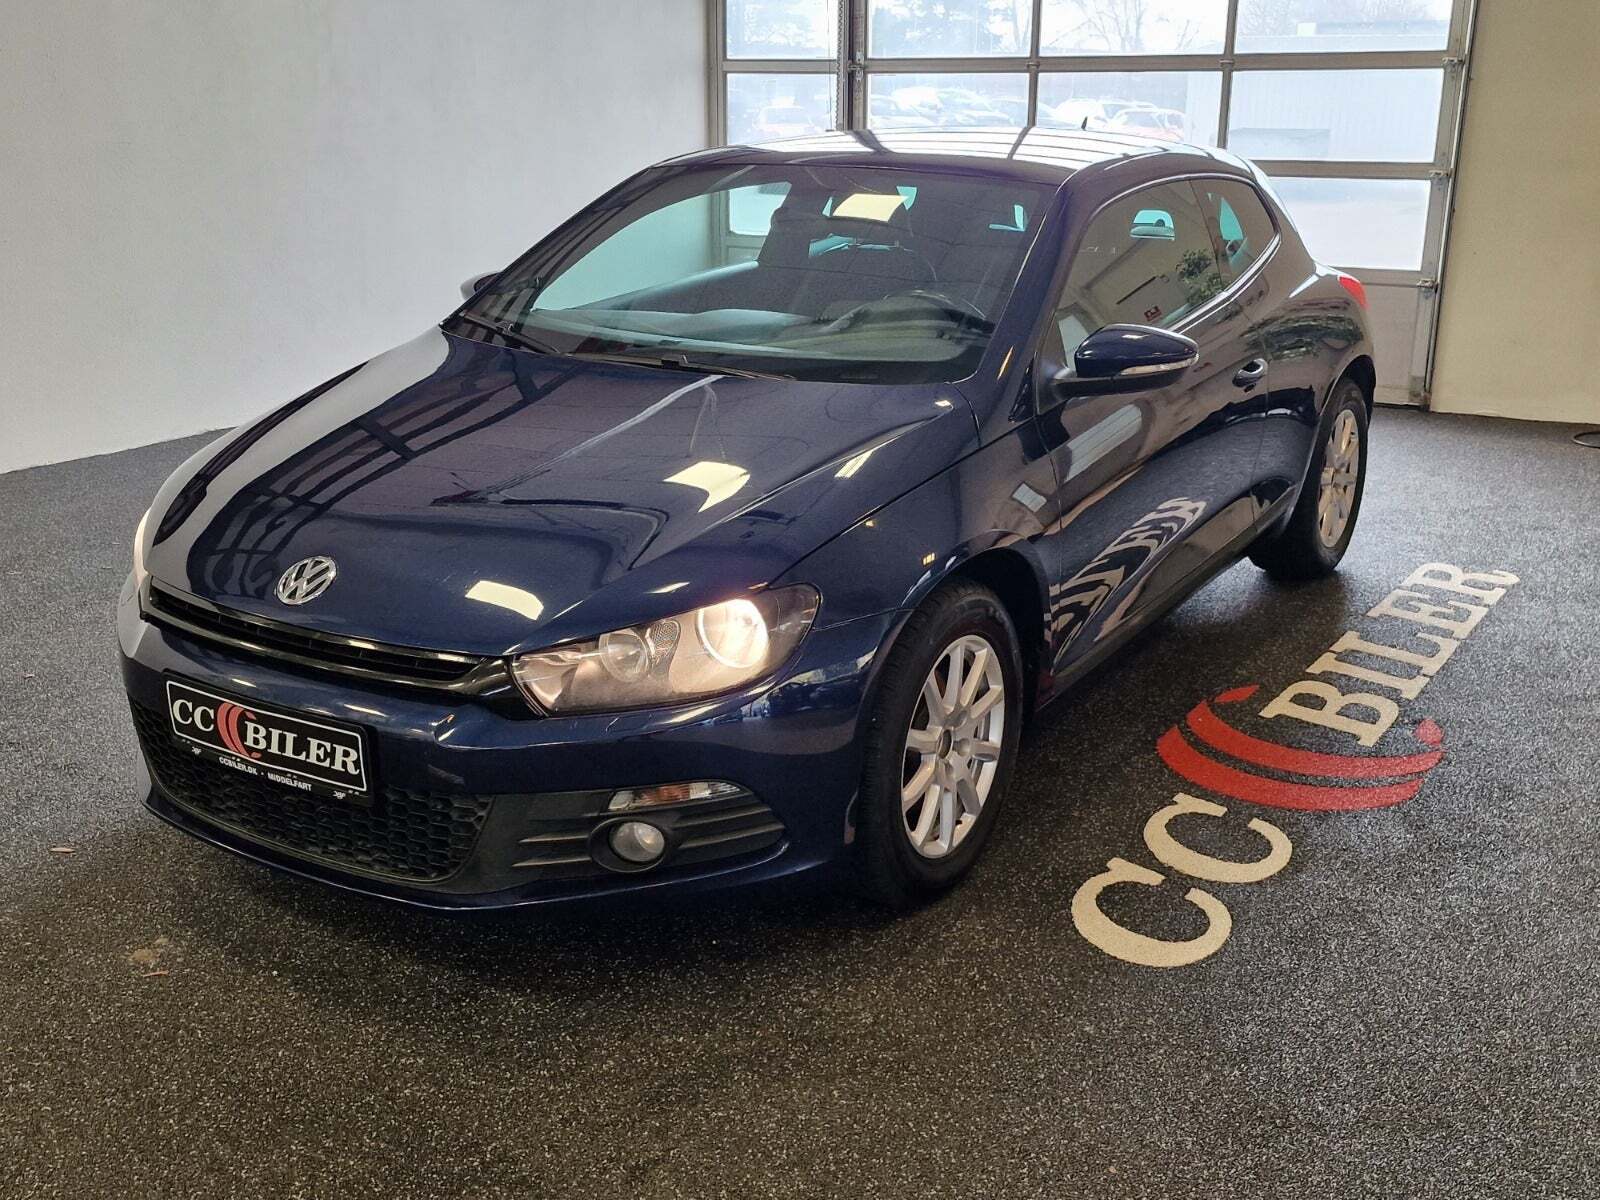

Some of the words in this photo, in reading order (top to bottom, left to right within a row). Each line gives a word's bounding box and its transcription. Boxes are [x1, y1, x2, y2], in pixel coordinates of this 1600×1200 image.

[277, 556, 336, 605] VW
[172, 699, 215, 732] CC
[244, 720, 360, 775] BILER
[1071, 793, 1293, 968] CC
[1258, 562, 1521, 747] BILER
[267, 772, 313, 792] MIDDELFART
